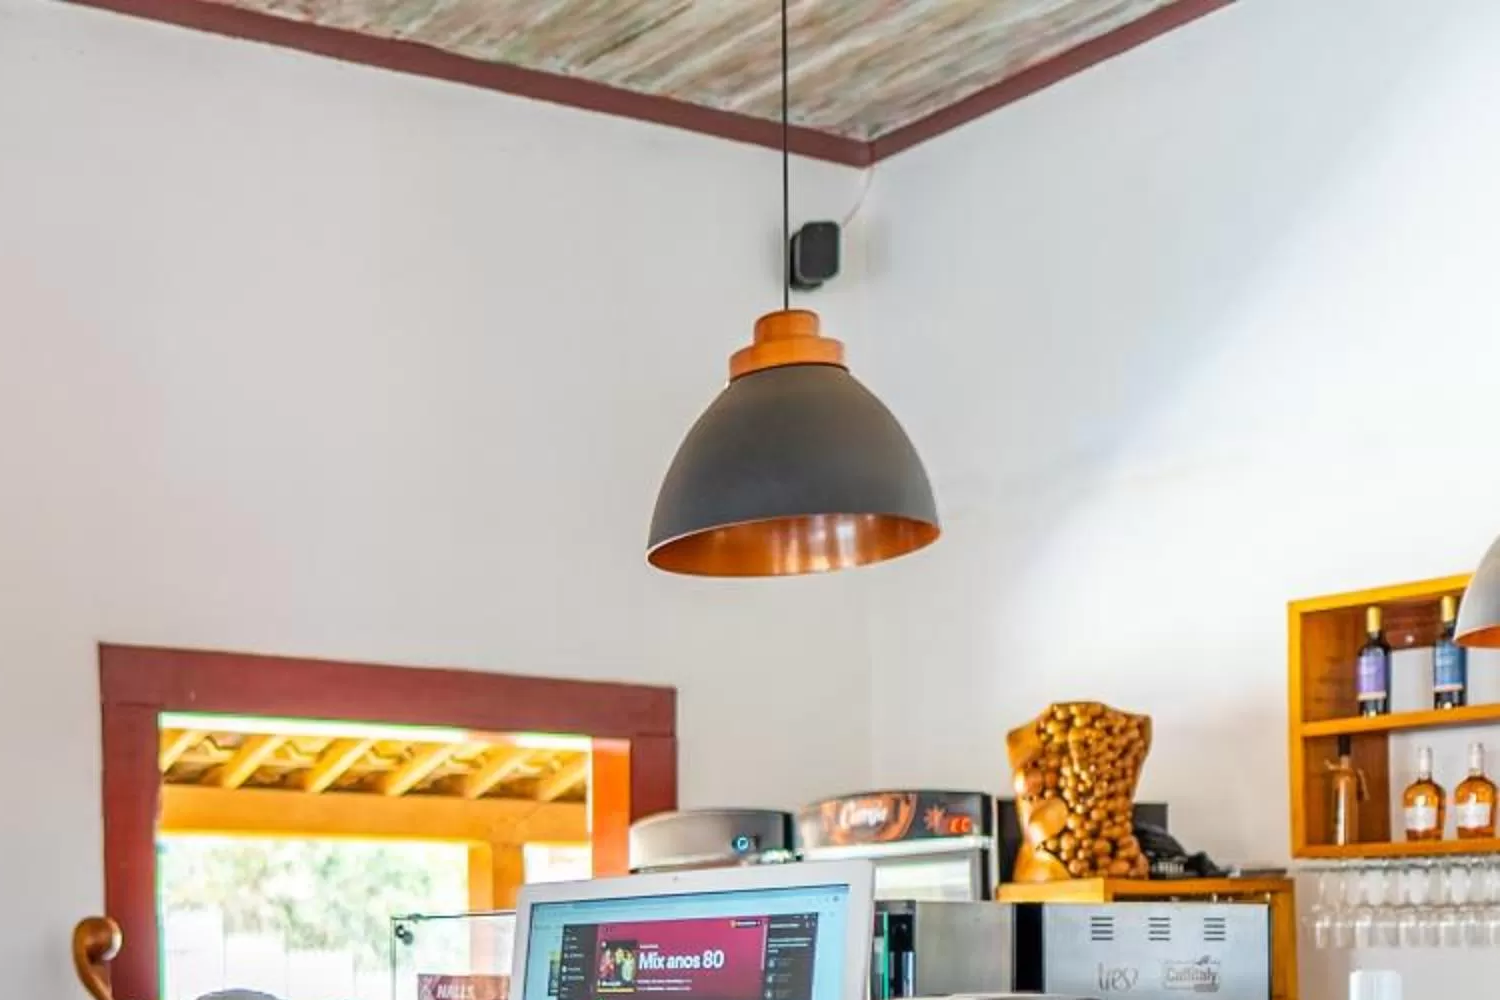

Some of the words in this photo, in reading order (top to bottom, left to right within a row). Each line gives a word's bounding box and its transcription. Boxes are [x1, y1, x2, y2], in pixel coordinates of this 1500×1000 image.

[639, 951, 665, 970] Mix
[666, 955, 701, 969] anos
[702, 949, 725, 969] 80
